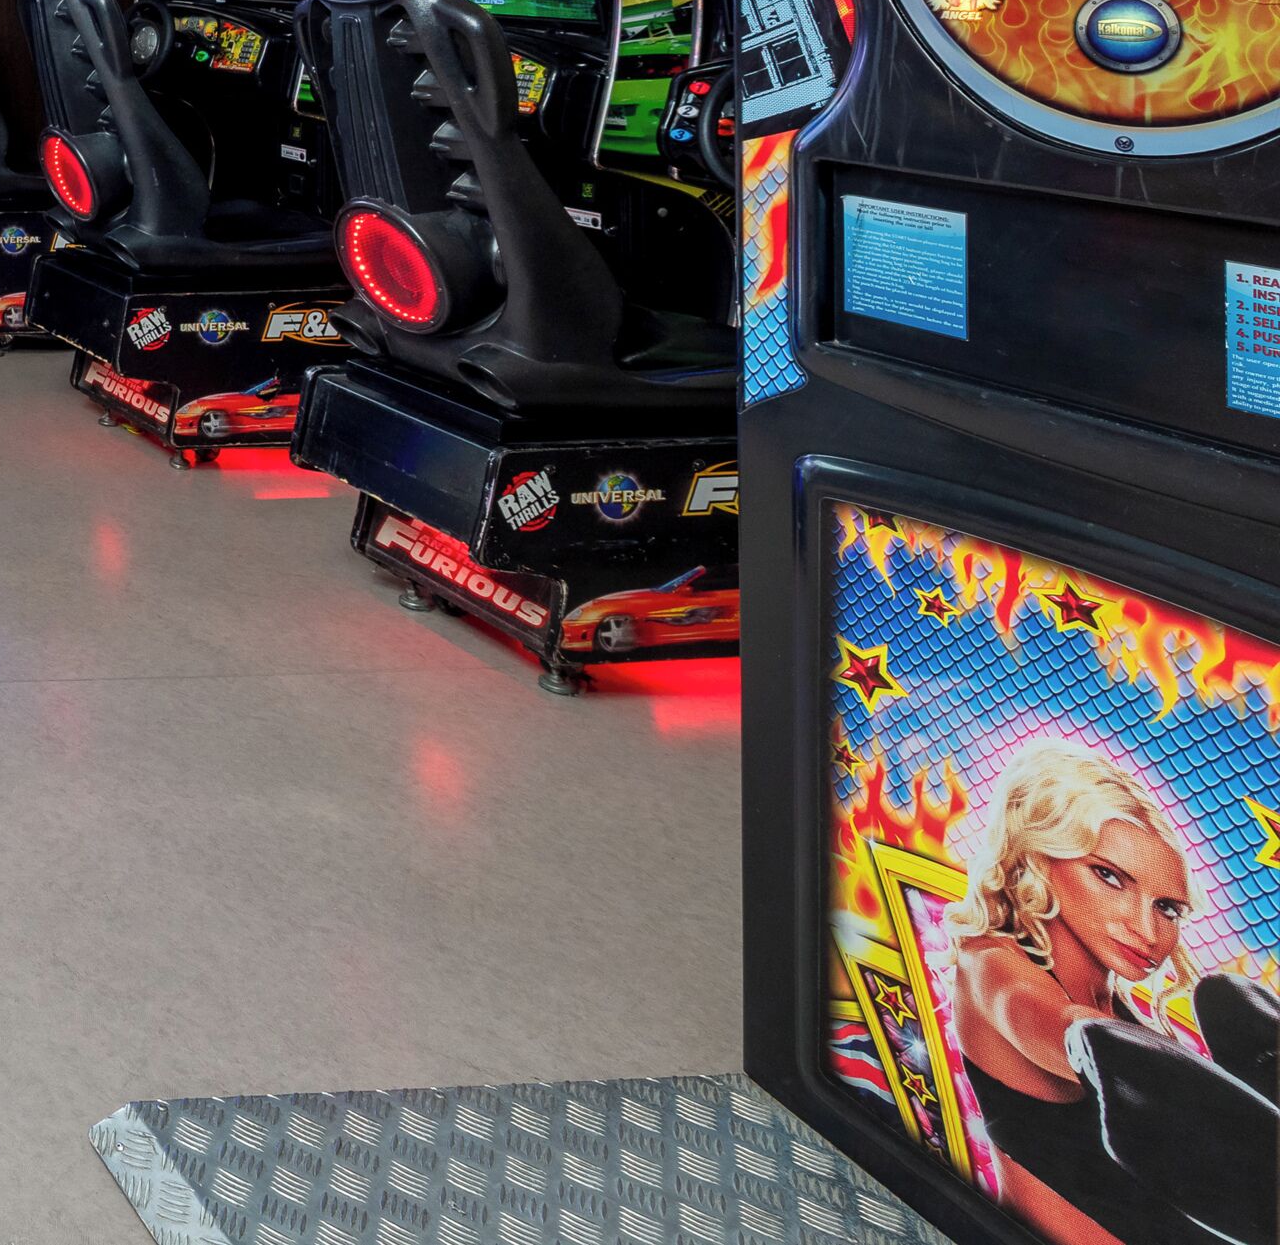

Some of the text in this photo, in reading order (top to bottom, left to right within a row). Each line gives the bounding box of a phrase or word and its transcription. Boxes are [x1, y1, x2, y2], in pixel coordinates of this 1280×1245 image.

[941, 10, 983, 22] ANGEL
[1097, 22, 1147, 38] Kalkomat
[1236, 273, 1249, 283] 1.
[1236, 300, 1249, 311] 2.
[127, 307, 168, 341] RAW
[180, 321, 250, 332] UNIVERSAL
[1236, 314, 1249, 325] 3.
[133, 321, 173, 351] THRILLS
[1236, 328, 1249, 339] 4.
[1236, 341, 1249, 353] 5.
[84, 361, 171, 423] FURIOUS
[497, 470, 554, 519] RAW
[571, 488, 666, 505] UNIVERSAL
[506, 489, 561, 532] THRILLS
[374, 514, 549, 627] FURIOUS
